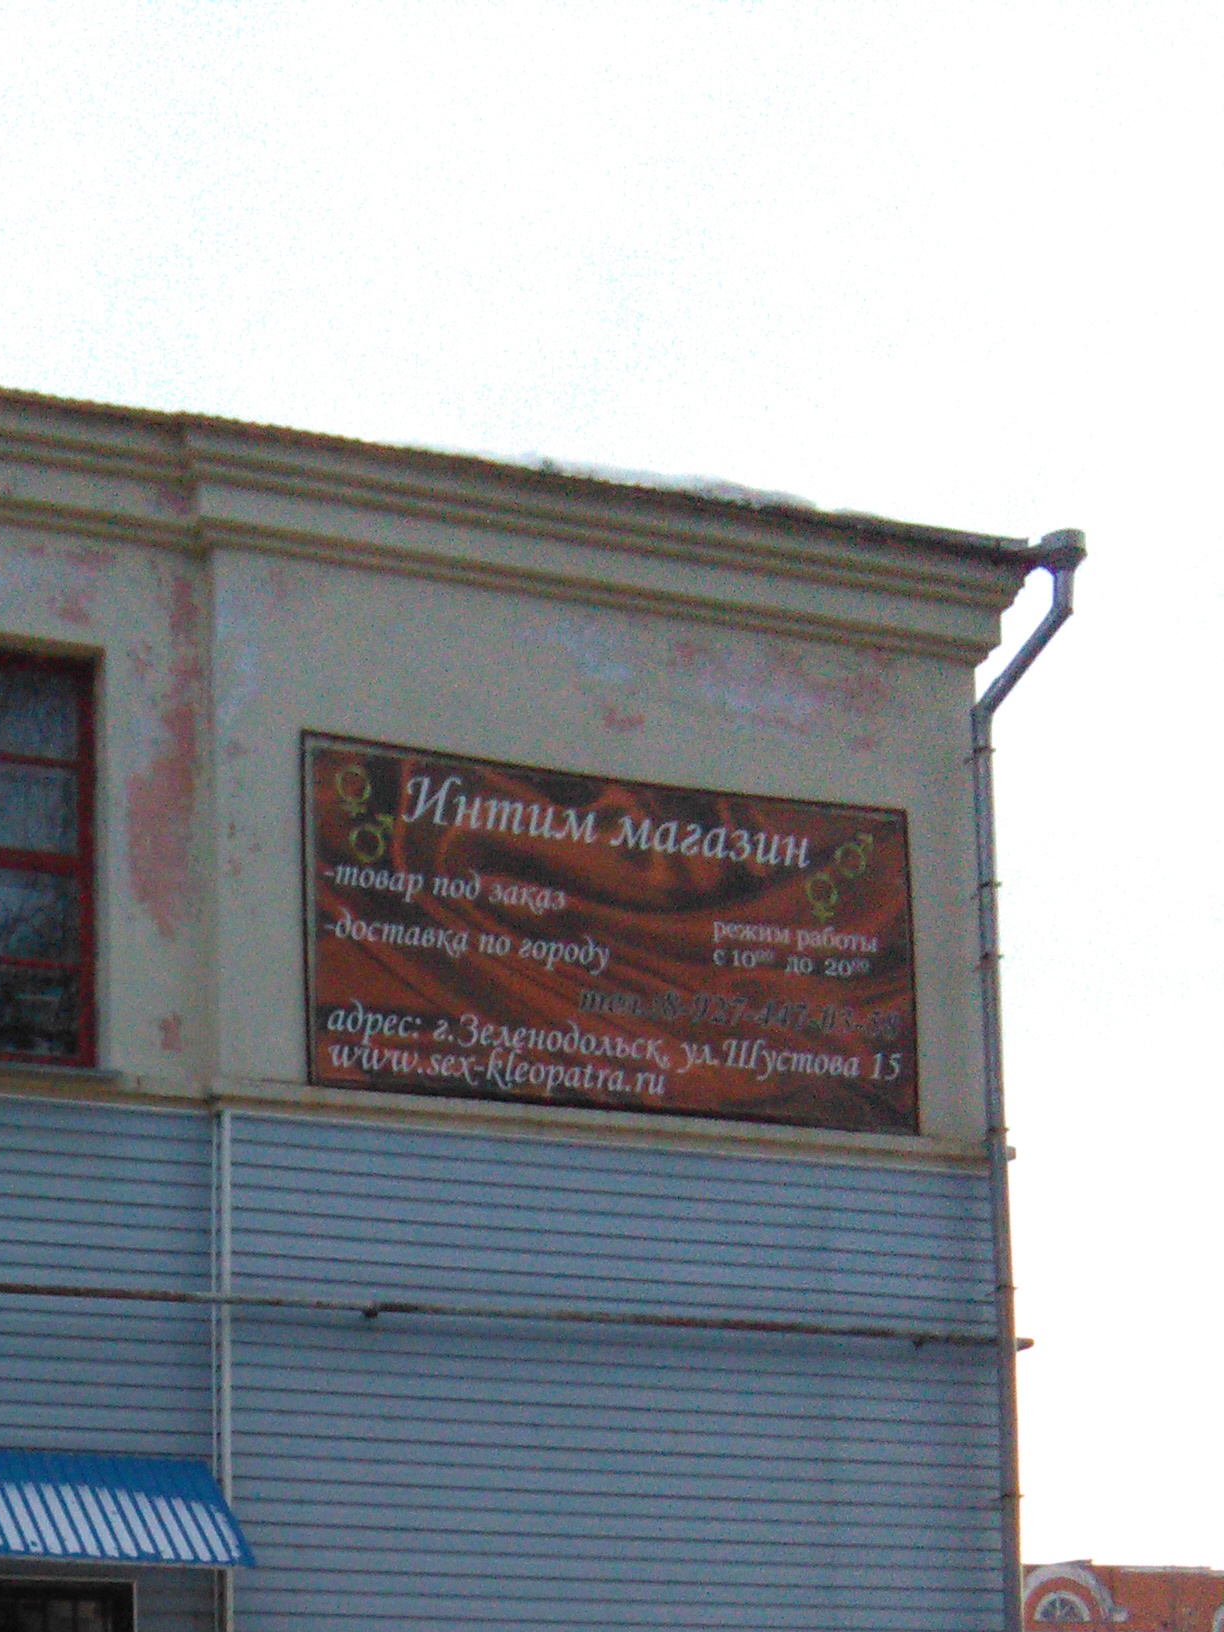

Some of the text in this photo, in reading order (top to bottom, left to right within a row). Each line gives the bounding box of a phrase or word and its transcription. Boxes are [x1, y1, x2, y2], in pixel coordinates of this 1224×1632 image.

[402, 775, 811, 868] Интим магазин
[325, 862, 566, 915] -товар под заказ
[326, 905, 610, 976] -доставка по городу
[713, 920, 878, 952] режим работы
[785, 956, 814, 975] до
[327, 998, 423, 1045] адрес:
[870, 1051, 903, 1081] 15
[328, 1042, 667, 1096] www.sex-kleopatra.ru
